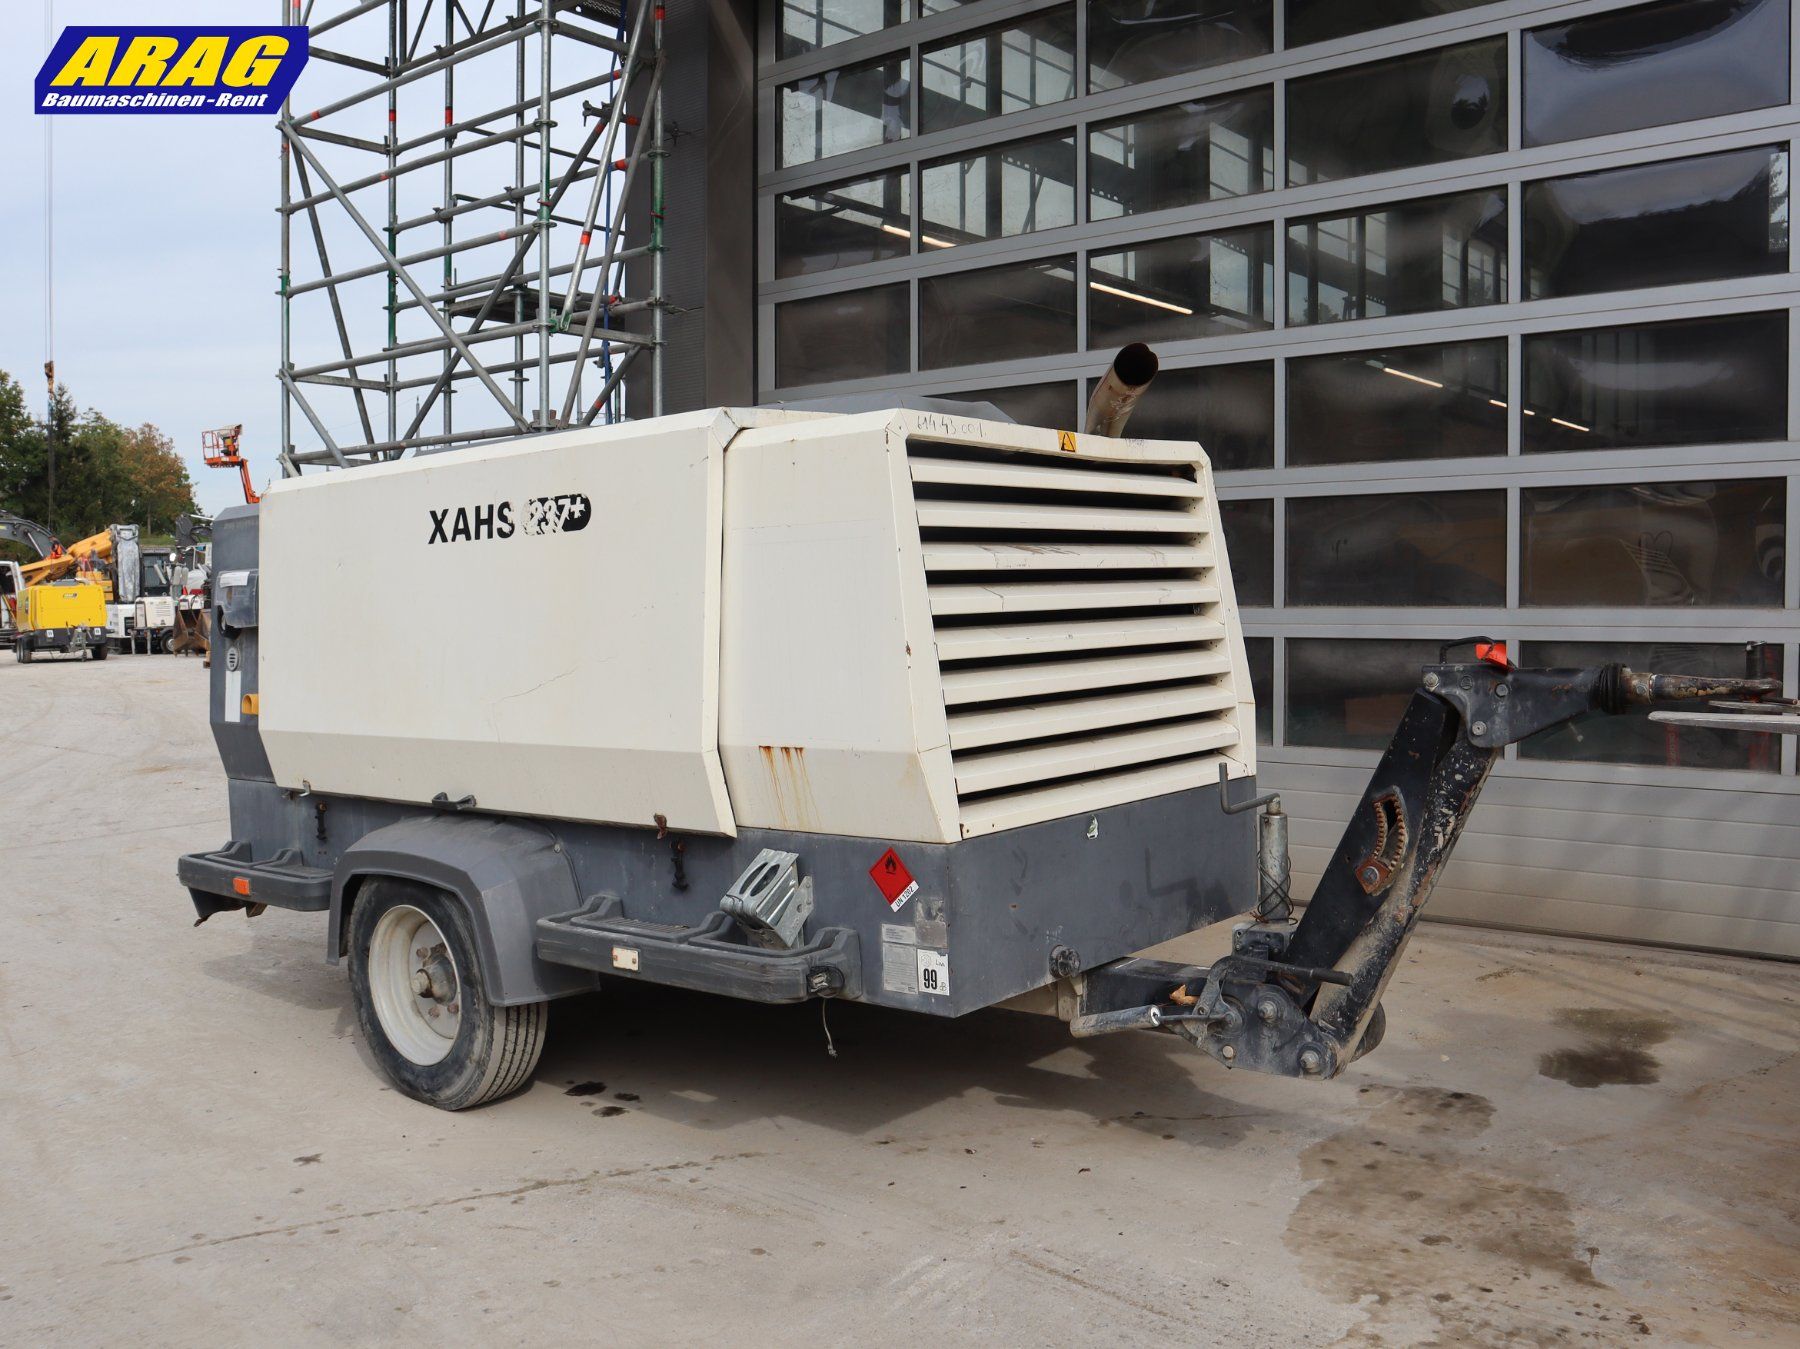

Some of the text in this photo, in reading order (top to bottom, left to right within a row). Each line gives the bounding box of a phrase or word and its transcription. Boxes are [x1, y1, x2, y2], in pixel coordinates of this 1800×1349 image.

[427, 501, 515, 545] XAHS
[894, 886, 915, 908] UN 1202
[923, 968, 938, 990] 99
